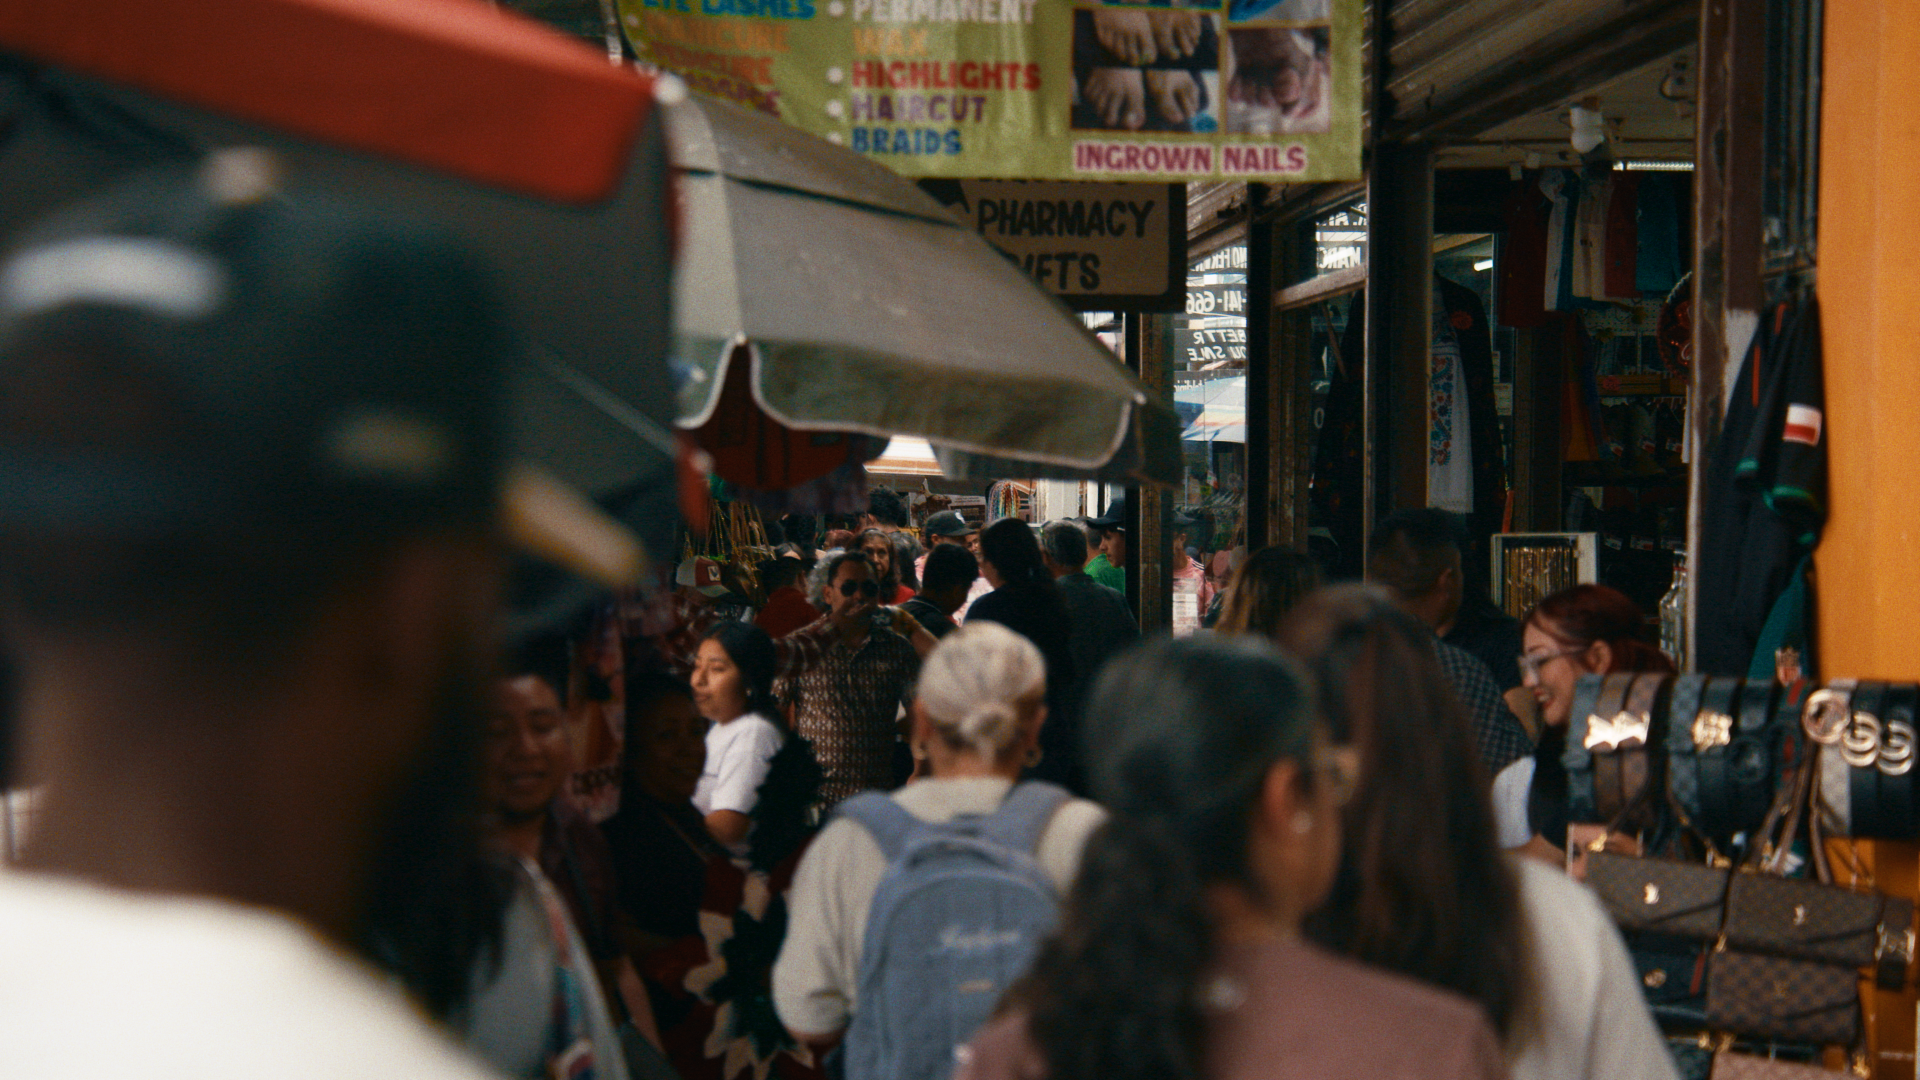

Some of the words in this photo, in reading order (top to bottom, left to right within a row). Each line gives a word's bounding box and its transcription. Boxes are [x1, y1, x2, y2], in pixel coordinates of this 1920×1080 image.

[852, 0, 1037, 25] PERMANENT
[852, 28, 928, 56] WAX
[851, 60, 1042, 91] HIGHLIGHTS
[850, 94, 987, 123] HAIRCUT
[850, 126, 963, 155] BRAIDS
[1075, 143, 1213, 173] INGROWN
[1224, 144, 1307, 173] NAILS
[977, 198, 1155, 238] PHARMACY
